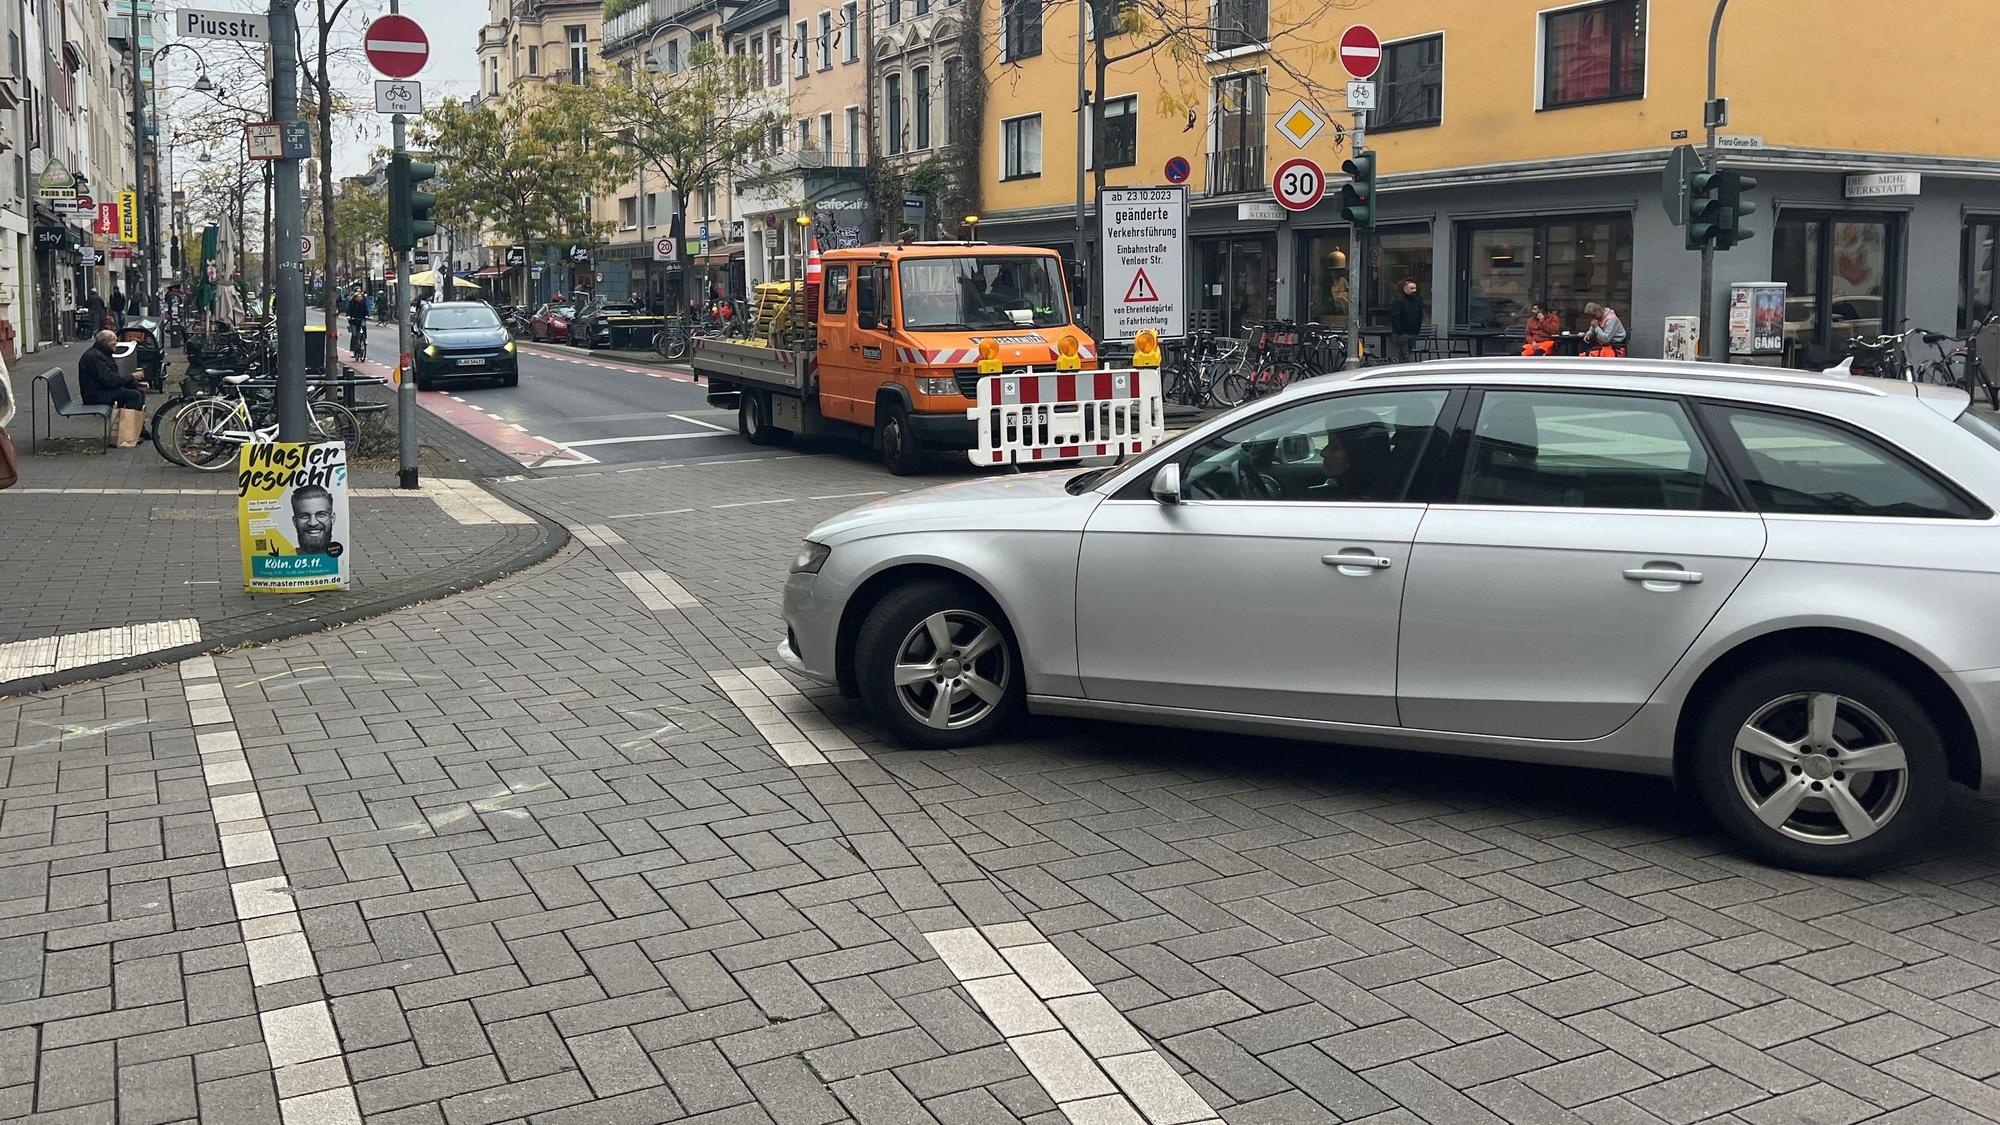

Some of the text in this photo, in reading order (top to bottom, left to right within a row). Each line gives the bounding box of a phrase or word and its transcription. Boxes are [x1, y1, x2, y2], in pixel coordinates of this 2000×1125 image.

[188, 13, 259, 39] Piusstr.
[391, 102, 407, 110] frei
[248, 126, 272, 135] H 200
[1719, 137, 1760, 147] Franz-Geuer-Str.
[1284, 172, 1313, 196] 30
[1848, 175, 1905, 186] DIE MEHL
[1848, 184, 1905, 195] WERKSTATT
[1111, 191, 1171, 201] ab 23.10.2023
[123, 194, 133, 238] ZEEMAN
[1115, 207, 1168, 224] geänderte
[40, 231, 62, 244] sky
[1108, 226, 1177, 238] Verkehrsführung
[1117, 243, 1167, 254] Einbahnstraße
[1121, 255, 1163, 265] Venloer Str.
[1126, 304, 1174, 314] Ehrenfeldgürtel
[1126, 317, 1168, 325] Fahrtrichtung
[1754, 333, 1781, 349] GÄNG
[1007, 416, 1013, 426] K
[249, 443, 339, 469] Master
[238, 463, 346, 497] gesucht?
[294, 558, 322, 568] 03.11.
[251, 576, 341, 587] www.mastermessen.de
